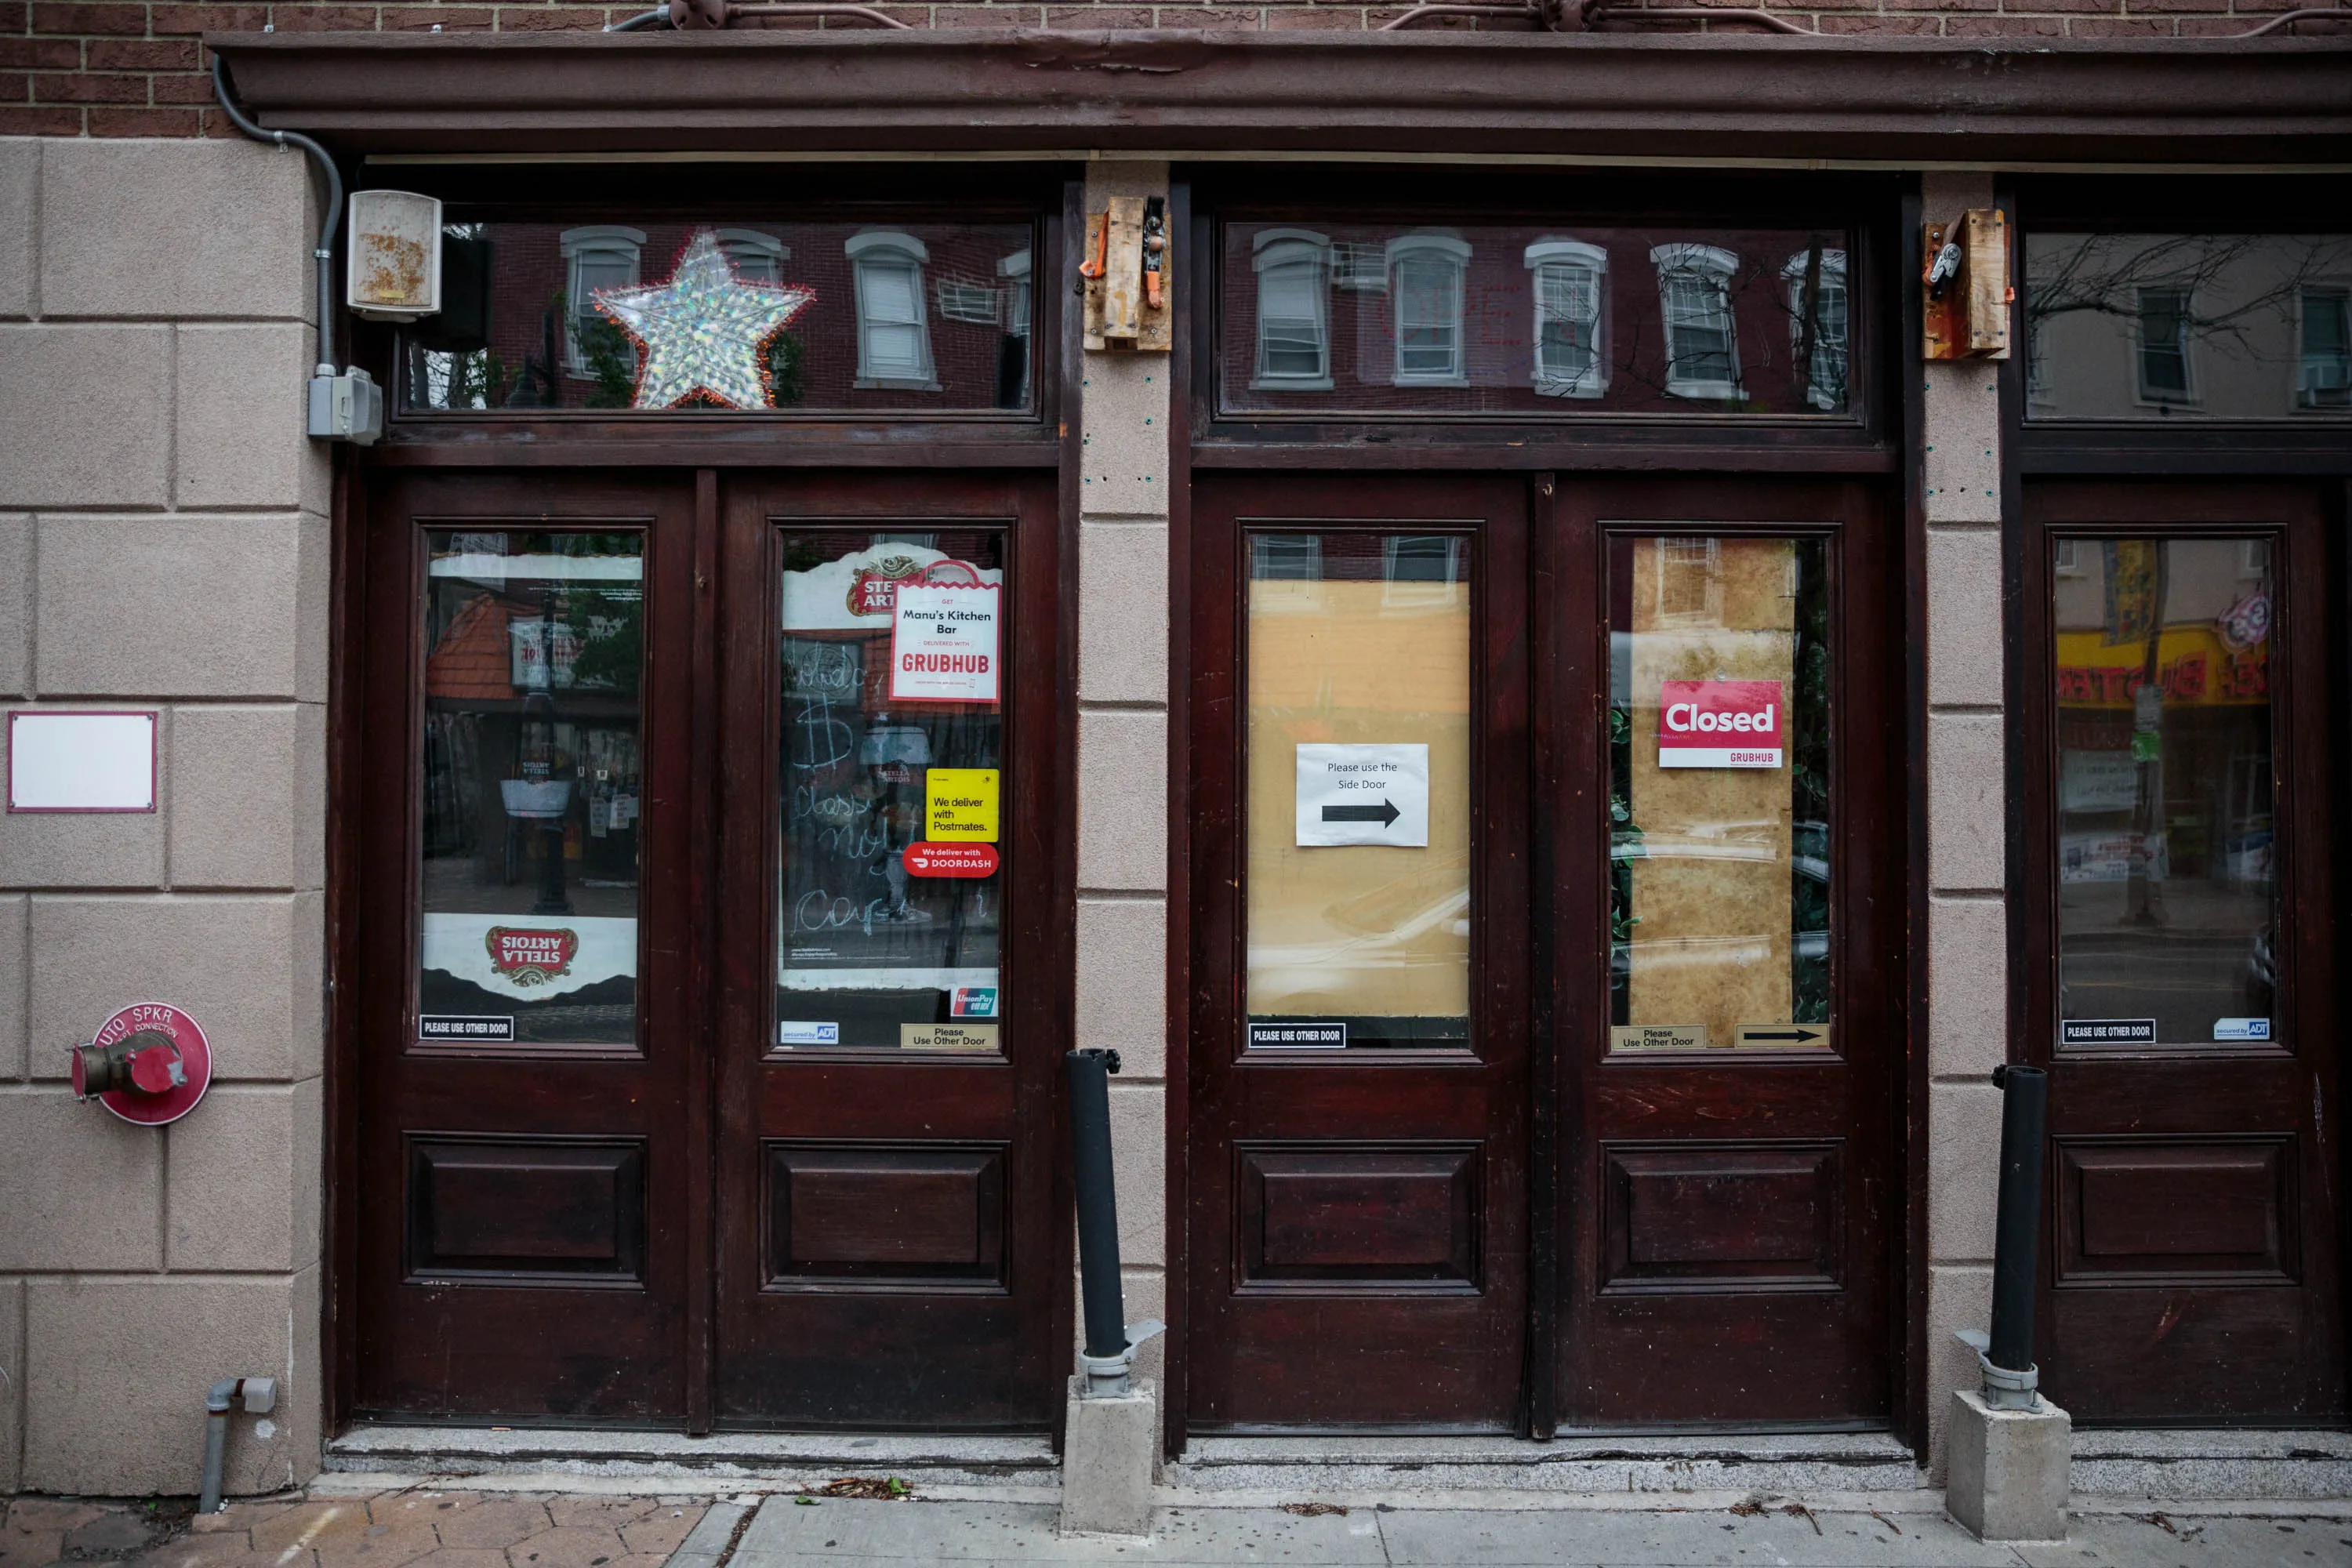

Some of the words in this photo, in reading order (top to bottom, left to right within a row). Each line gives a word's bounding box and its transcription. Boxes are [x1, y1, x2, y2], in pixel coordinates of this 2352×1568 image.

[864, 580, 895, 593] STE
[863, 594, 895, 608] ART
[902, 609, 945, 621] Manu's
[947, 610, 992, 622] Kitchen
[937, 624, 957, 634] Bar
[902, 652, 990, 674] GRUBHUB
[1665, 702, 1774, 732] Closed
[1730, 752, 1774, 762] GRUBHUB
[1327, 763, 1359, 772] Please
[1381, 763, 1398, 772] the
[1338, 779, 1359, 789] Side
[1362, 780, 1387, 789] Door
[934, 797, 949, 807] We
[951, 797, 984, 807] deliver
[934, 810, 954, 818] with
[934, 821, 987, 831] Postmates.
[931, 858, 992, 868] DOORDASH
[501, 936, 562, 950] ARTOIS
[502, 949, 561, 964] STELLA
[957, 993, 993, 1004] UnionPay
[100, 1018, 125, 1045] UTO
[132, 1006, 172, 1024] SPKR
[135, 1023, 179, 1039] CONNECTION
[425, 1021, 450, 1033] PLEASE
[451, 1022, 465, 1033] USE
[466, 1022, 488, 1034] OTHER
[488, 1023, 508, 1034] DOOR
[2067, 1026, 2092, 1037] PLEASE
[2093, 1026, 2107, 1037] USE
[2108, 1026, 2130, 1036] OTHER
[2131, 1025, 2151, 1036] DOOR
[2249, 1022, 2267, 1034] ADT
[818, 1027, 836, 1039] ADT
[934, 1027, 964, 1036] Please
[1254, 1030, 1279, 1041] PLEASE
[1281, 1030, 1295, 1041] USE
[1296, 1030, 1319, 1041] OTHER
[1320, 1030, 1340, 1041] DOOR
[1643, 1029, 1673, 1038] Please
[913, 1036, 933, 1045] Use
[933, 1036, 961, 1045] Other
[963, 1036, 985, 1045] Door
[1623, 1038, 1640, 1047] Use
[1643, 1038, 1668, 1047] Other
[1671, 1037, 1694, 1046] Door
